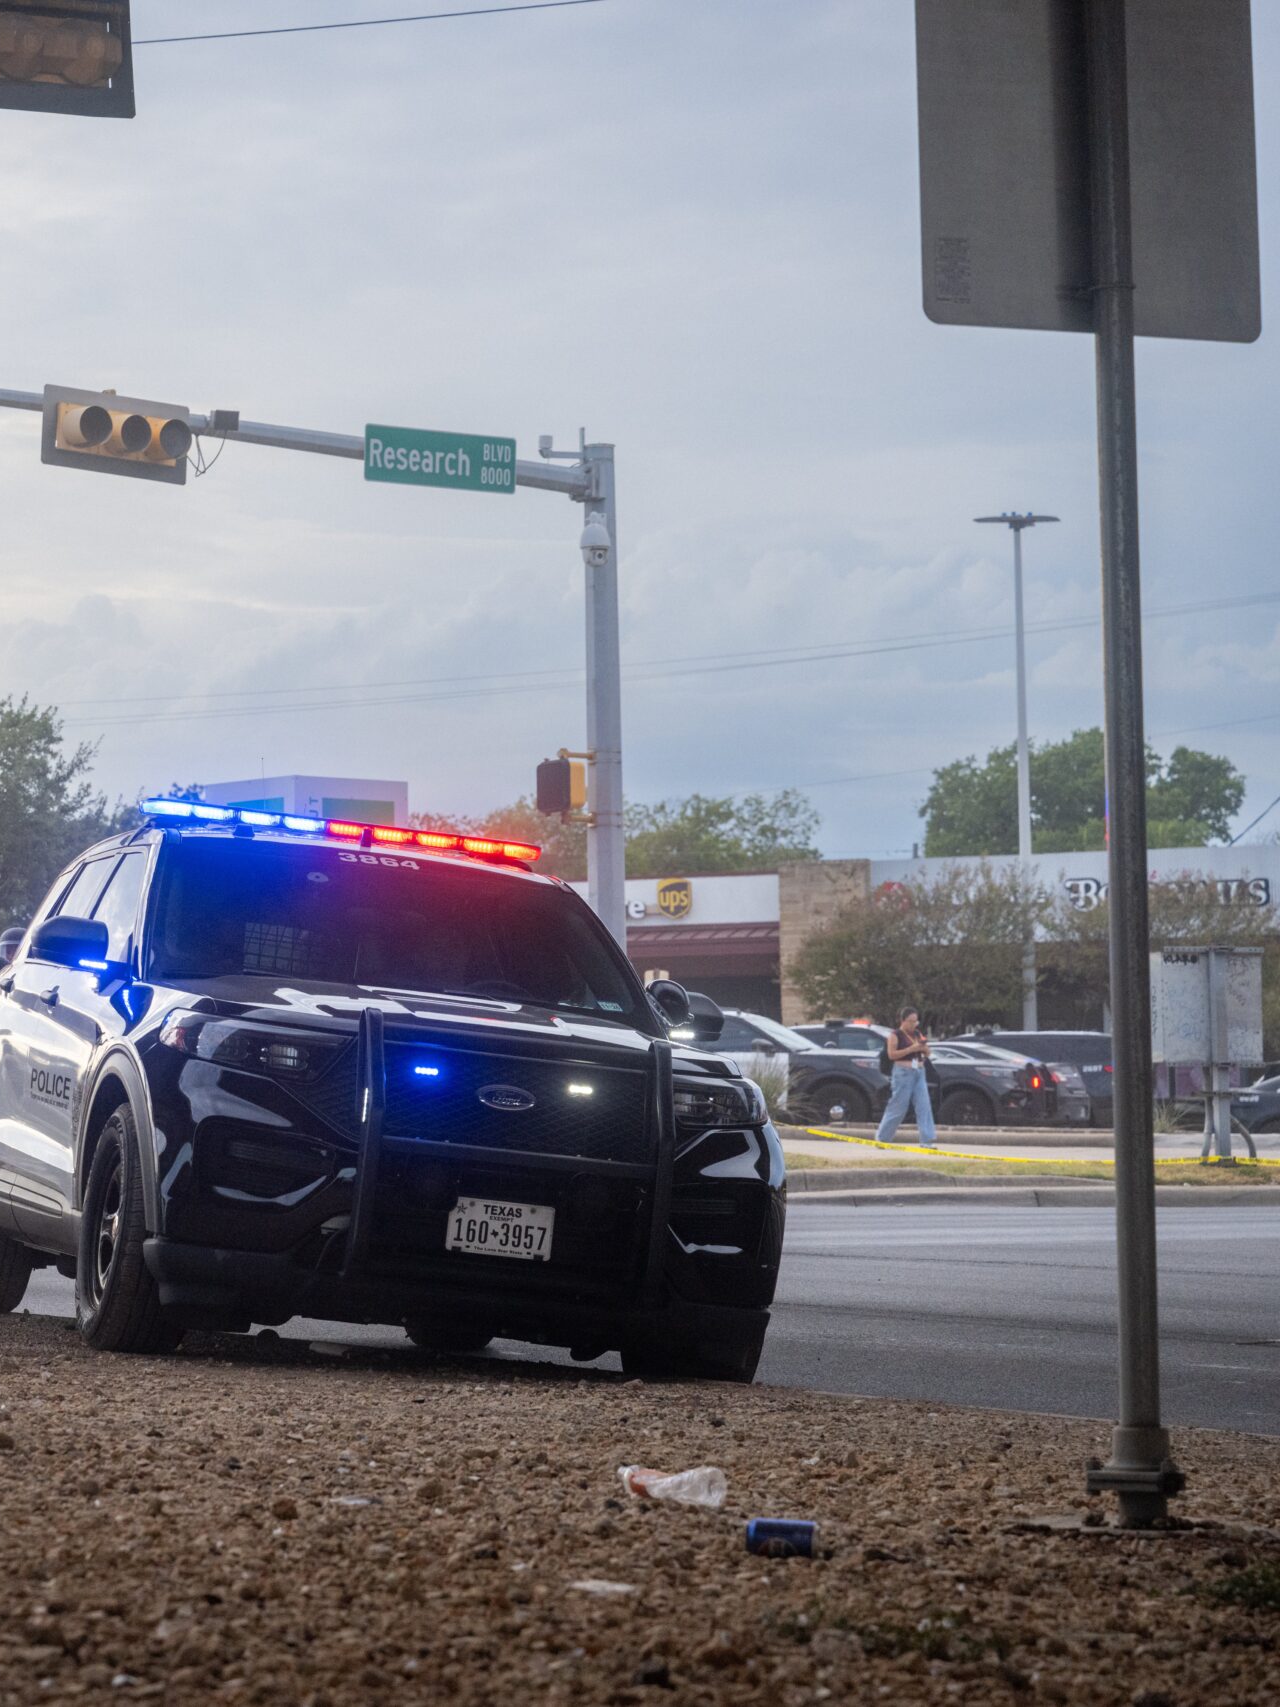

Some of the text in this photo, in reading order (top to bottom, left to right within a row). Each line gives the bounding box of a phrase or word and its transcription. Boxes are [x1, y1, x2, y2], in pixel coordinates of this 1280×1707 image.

[369, 438, 470, 477] Research
[483, 443, 511, 463] BLVD
[480, 467, 511, 486] 8000
[338, 852, 420, 870] 3864
[660, 890, 688, 912] ups
[30, 1068, 71, 1100] POLICE
[483, 1204, 522, 1218] TEXAS
